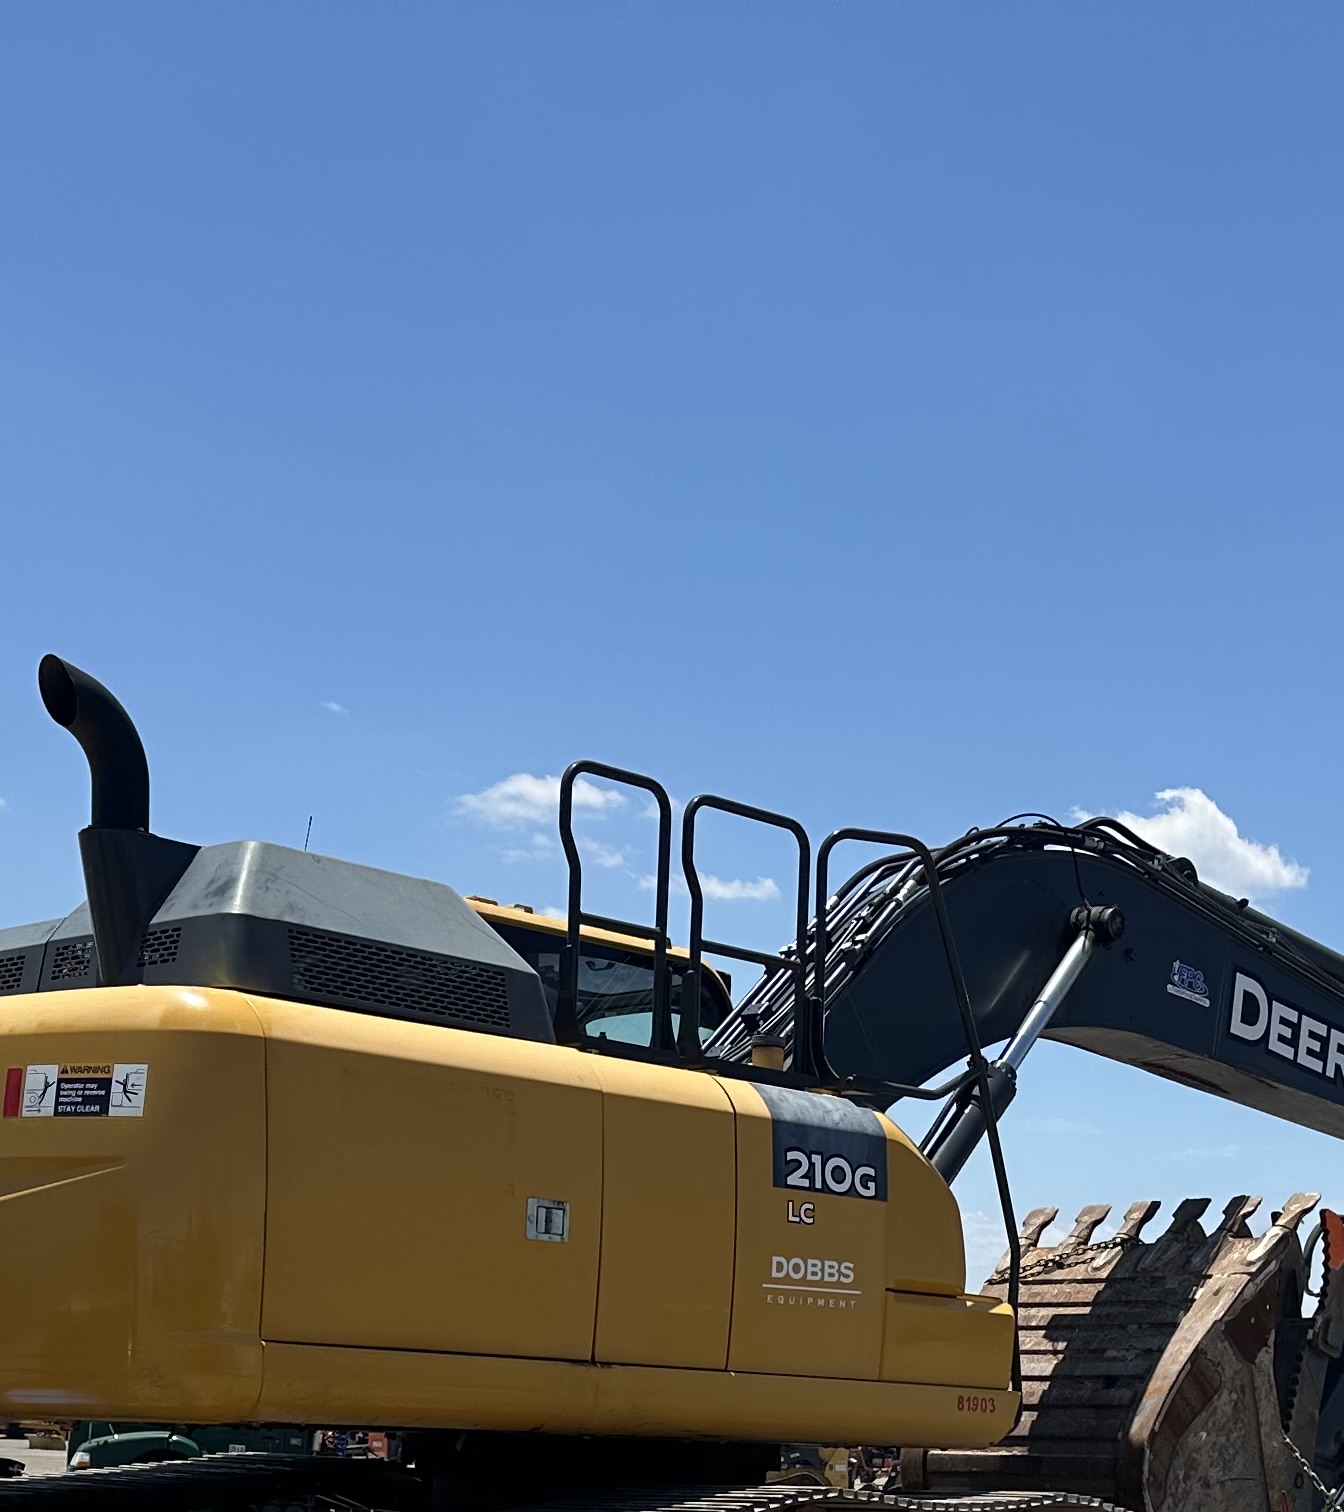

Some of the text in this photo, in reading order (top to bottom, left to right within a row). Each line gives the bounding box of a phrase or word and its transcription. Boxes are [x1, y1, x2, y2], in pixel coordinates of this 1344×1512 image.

[69, 1065, 111, 1074] WARNING
[786, 1150, 876, 1197] 210G
[787, 1201, 815, 1224] LC
[771, 1255, 855, 1284] DOBBS
[766, 1294, 857, 1309] EQUIPMENT
[957, 1395, 996, 1413] 81903
